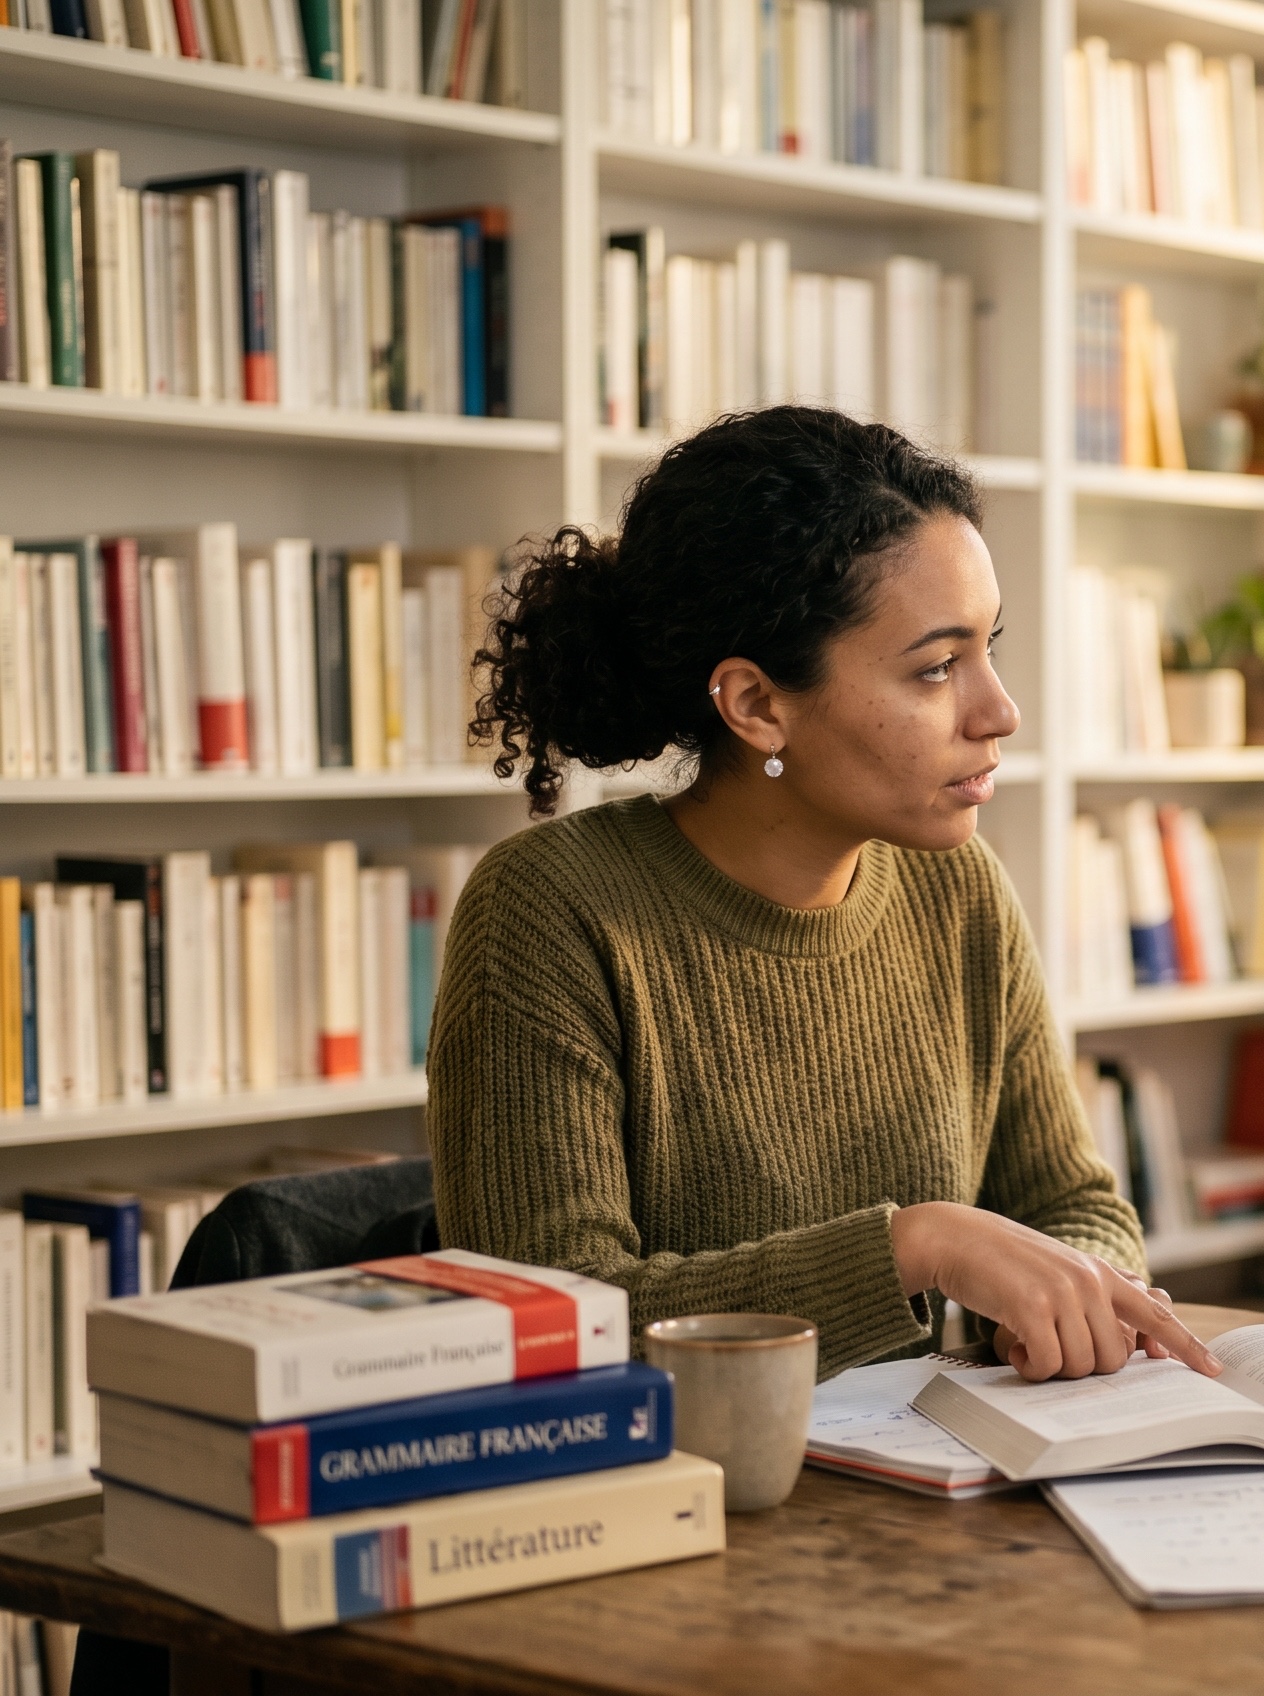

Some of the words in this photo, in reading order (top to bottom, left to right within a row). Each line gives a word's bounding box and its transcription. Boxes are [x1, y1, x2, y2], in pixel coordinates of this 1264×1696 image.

[332, 1353, 424, 1380] Grammaire
[430, 1339, 505, 1364] Française
[320, 1436, 476, 1483] GRAMMAIRE
[479, 1413, 608, 1458] FRANÇAISE
[428, 1521, 604, 1576] Littérature
